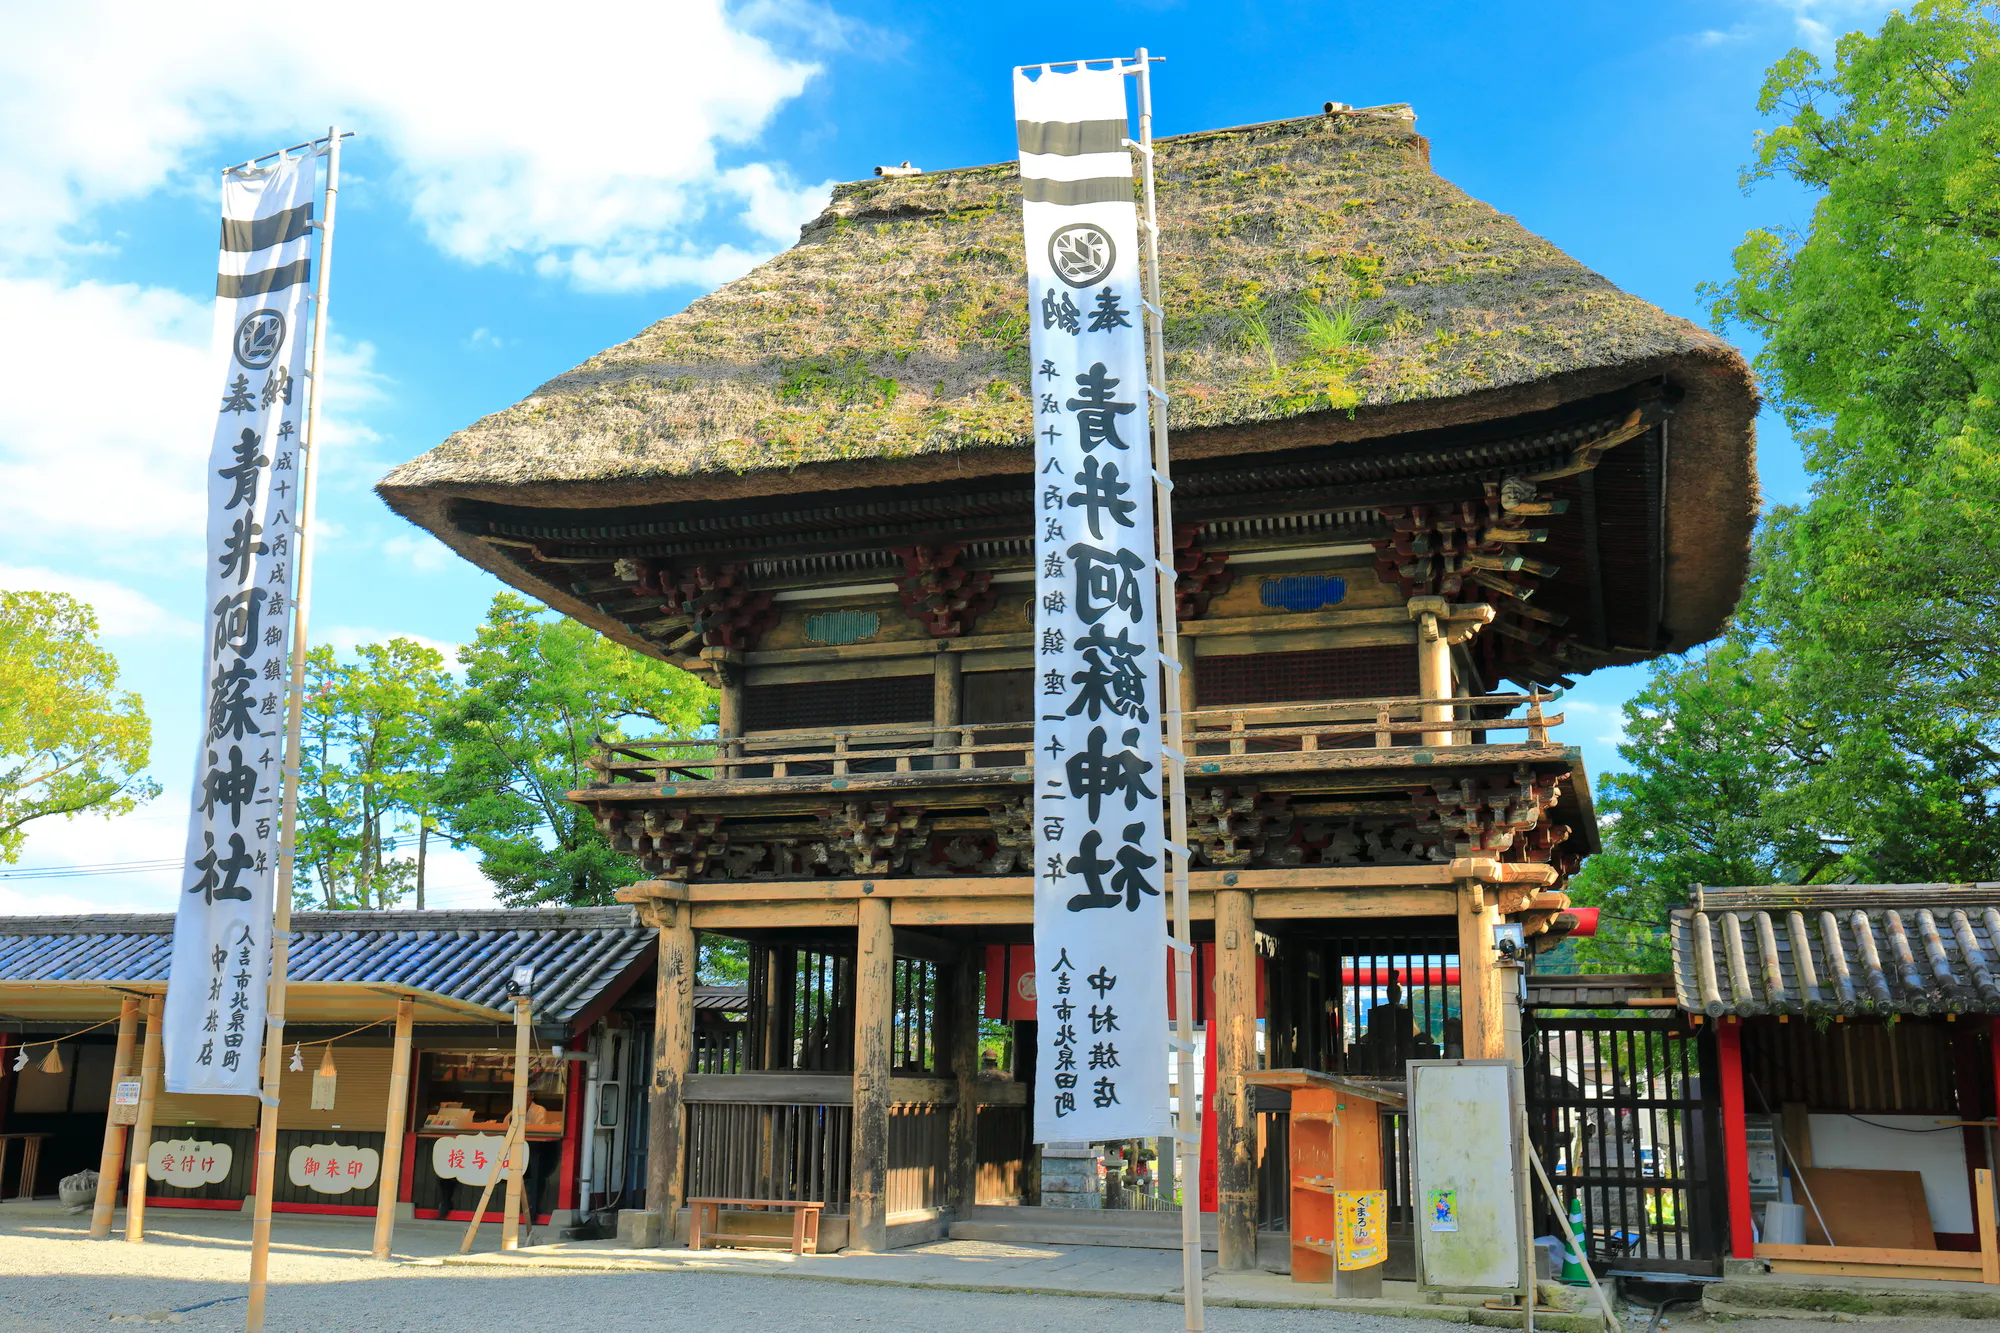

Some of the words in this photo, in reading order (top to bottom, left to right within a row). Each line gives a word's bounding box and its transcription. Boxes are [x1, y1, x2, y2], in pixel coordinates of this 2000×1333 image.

[219, 366, 294, 416] 奉納
[189, 427, 270, 906] 青井阿蘇神社
[196, 943, 228, 1066] 中村旗店
[221, 924, 255, 1073] 人吉市北泉田町
[161, 1153, 215, 1173] 受付け
[304, 1157, 363, 1179] 御朱印
[1357, 1197, 1369, 1238] くまろん
